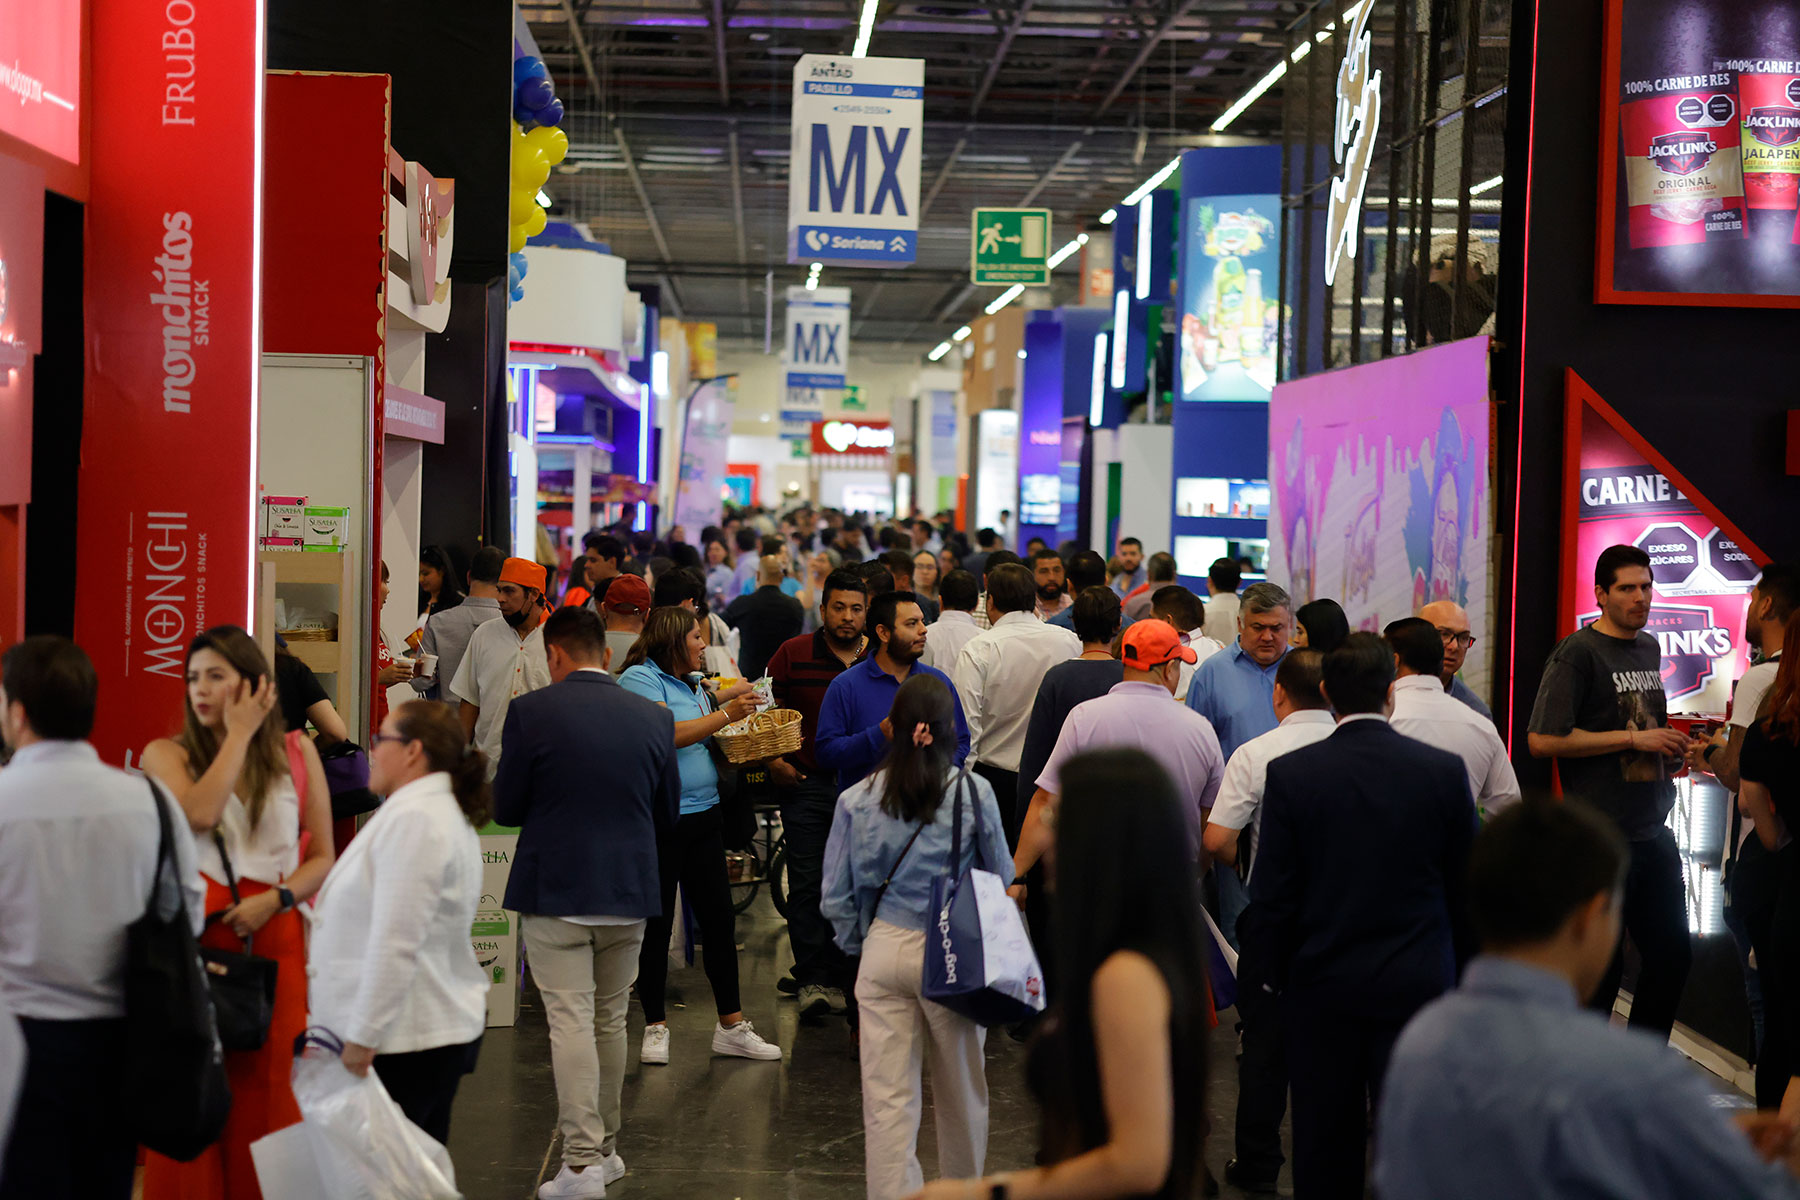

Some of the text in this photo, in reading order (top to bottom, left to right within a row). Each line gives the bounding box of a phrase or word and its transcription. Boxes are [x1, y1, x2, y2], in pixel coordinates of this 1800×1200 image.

[1756, 61, 1793, 73] CARNE
[808, 83, 853, 94] PASILLO
[1625, 73, 1730, 94] 100% CARNE DE RES
[1647, 144, 1679, 159] JACK
[808, 123, 911, 216] MX
[1658, 176, 1712, 189] ORIGINAL
[831, 236, 885, 250] Soriana
[194, 280, 210, 346] SNACK
[793, 322, 841, 365] MX
[1582, 474, 1671, 506] CARNE
[197, 533, 208, 573] SNACK
[1648, 543, 1688, 553] EXCESO
[143, 511, 188, 679] MONCHI
